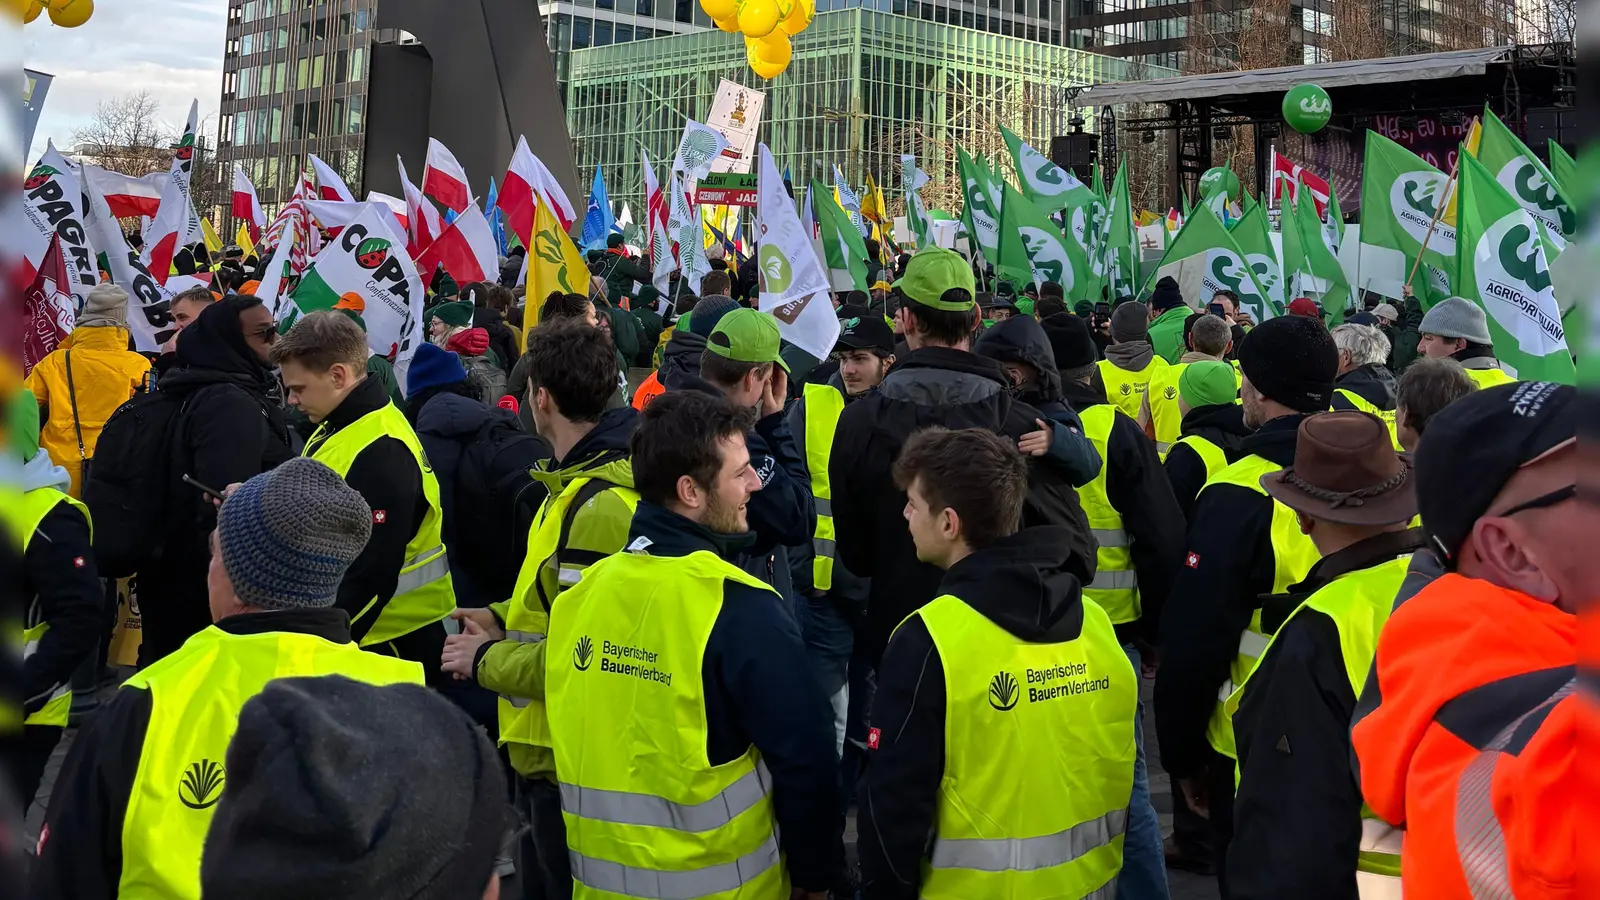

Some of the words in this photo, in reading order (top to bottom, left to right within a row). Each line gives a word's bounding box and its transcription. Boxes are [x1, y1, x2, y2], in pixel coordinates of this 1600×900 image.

[602, 640, 658, 664] Bayerischer
[1026, 662, 1087, 685] Bayerischer
[1028, 675, 1109, 703] BauernVerband
